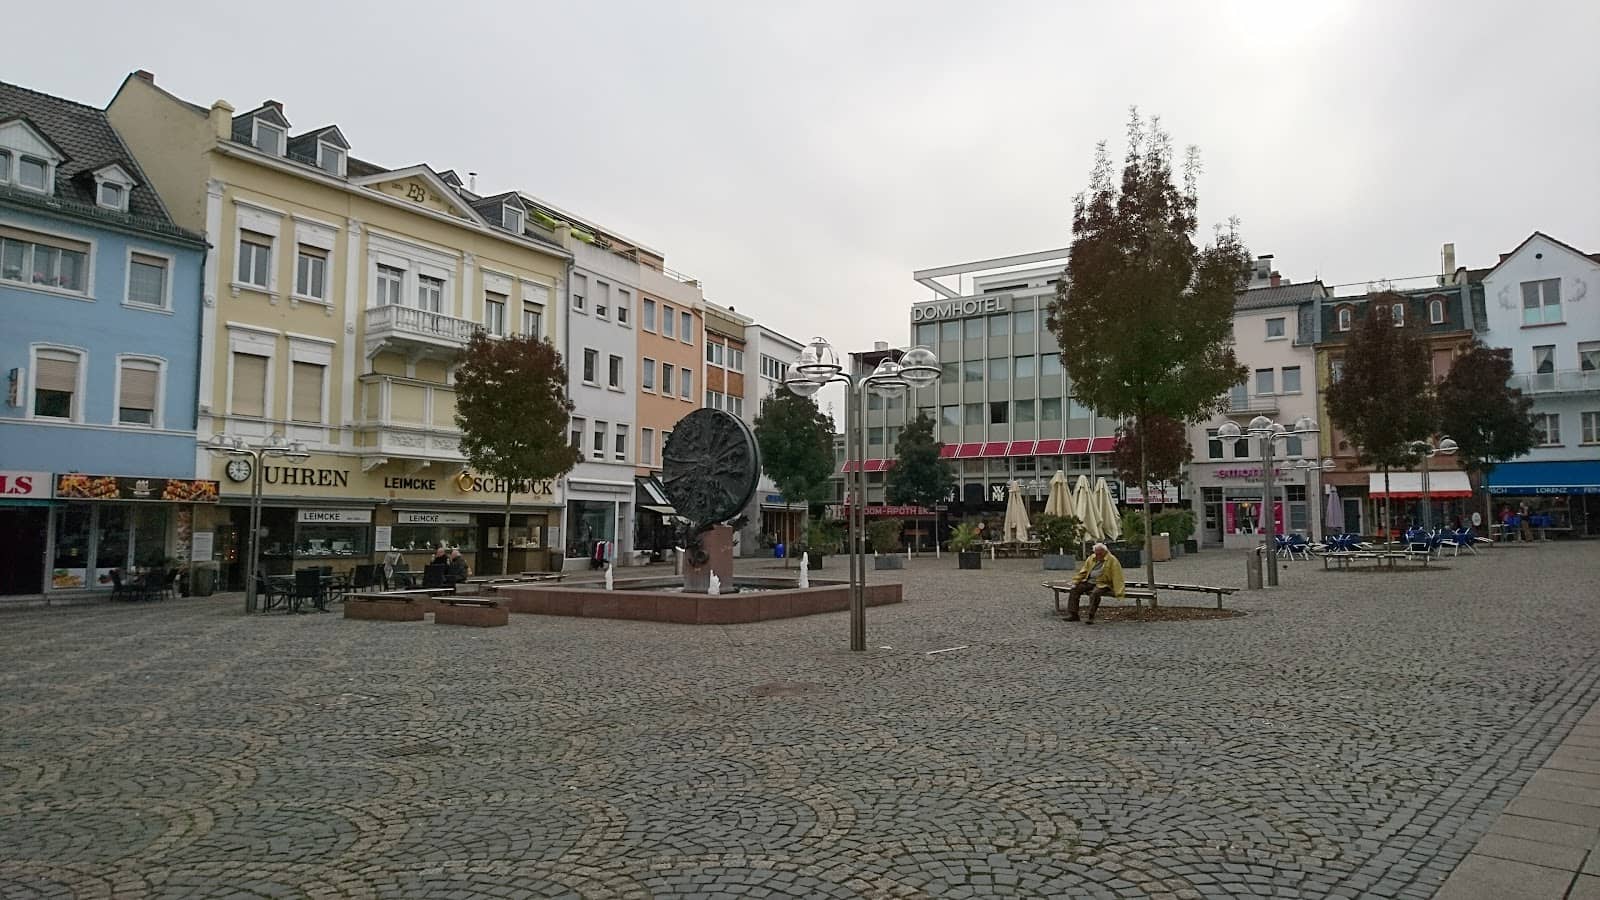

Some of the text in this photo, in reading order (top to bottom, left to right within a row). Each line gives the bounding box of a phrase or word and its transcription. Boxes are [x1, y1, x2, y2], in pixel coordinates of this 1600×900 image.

[913, 296, 1006, 321] DOMHOTEL
[263, 466, 350, 487] UHREN
[384, 477, 436, 490] LEIMCKE
[864, 504, 936, 515] DOM-APOTHEK
[304, 512, 340, 521] LEIMCKE
[409, 515, 438, 523] LEIMCKE
